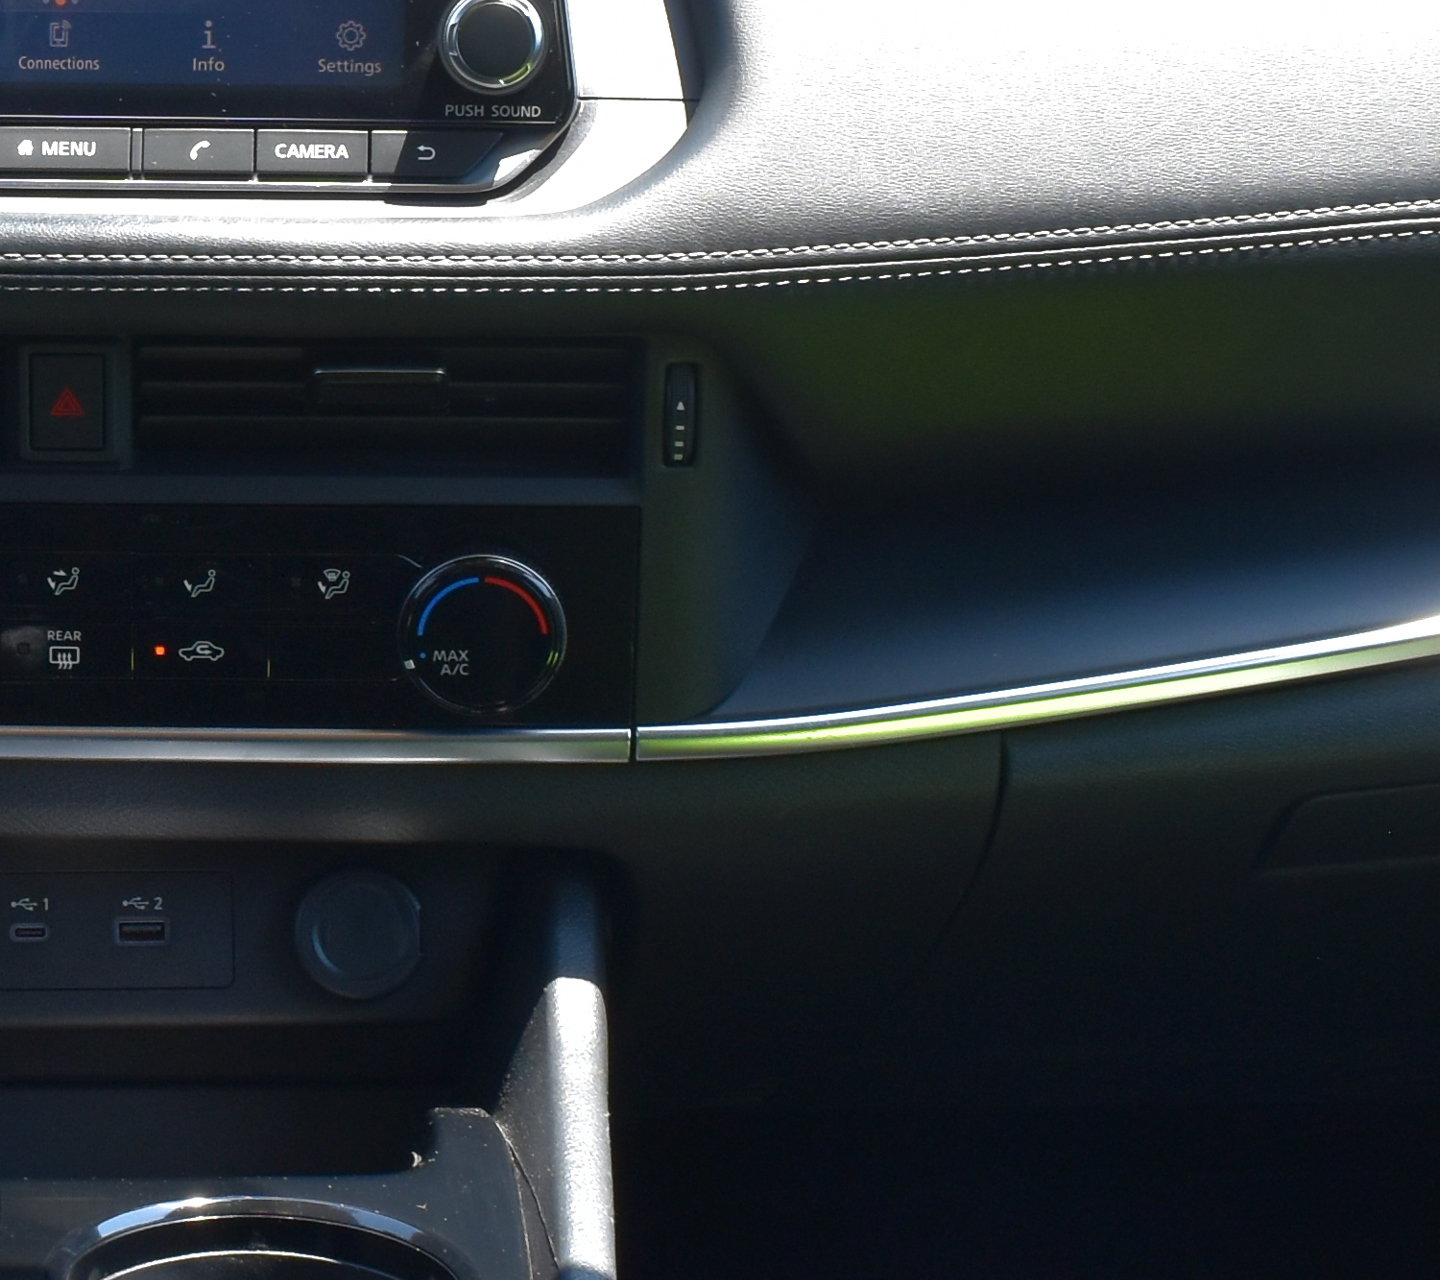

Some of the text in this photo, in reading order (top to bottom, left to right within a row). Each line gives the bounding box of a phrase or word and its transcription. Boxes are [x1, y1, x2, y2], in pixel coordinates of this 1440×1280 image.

[18, 54, 100, 71] Connections
[192, 54, 225, 72] Info
[318, 55, 381, 75] Settings
[445, 104, 541, 117] PUSH SOUND
[42, 139, 97, 157] MENU
[275, 141, 348, 160] CAMERA
[47, 630, 82, 641] REAR
[433, 650, 468, 662] MAX
[440, 664, 470, 676] A/C
[154, 897, 163, 911] 2
